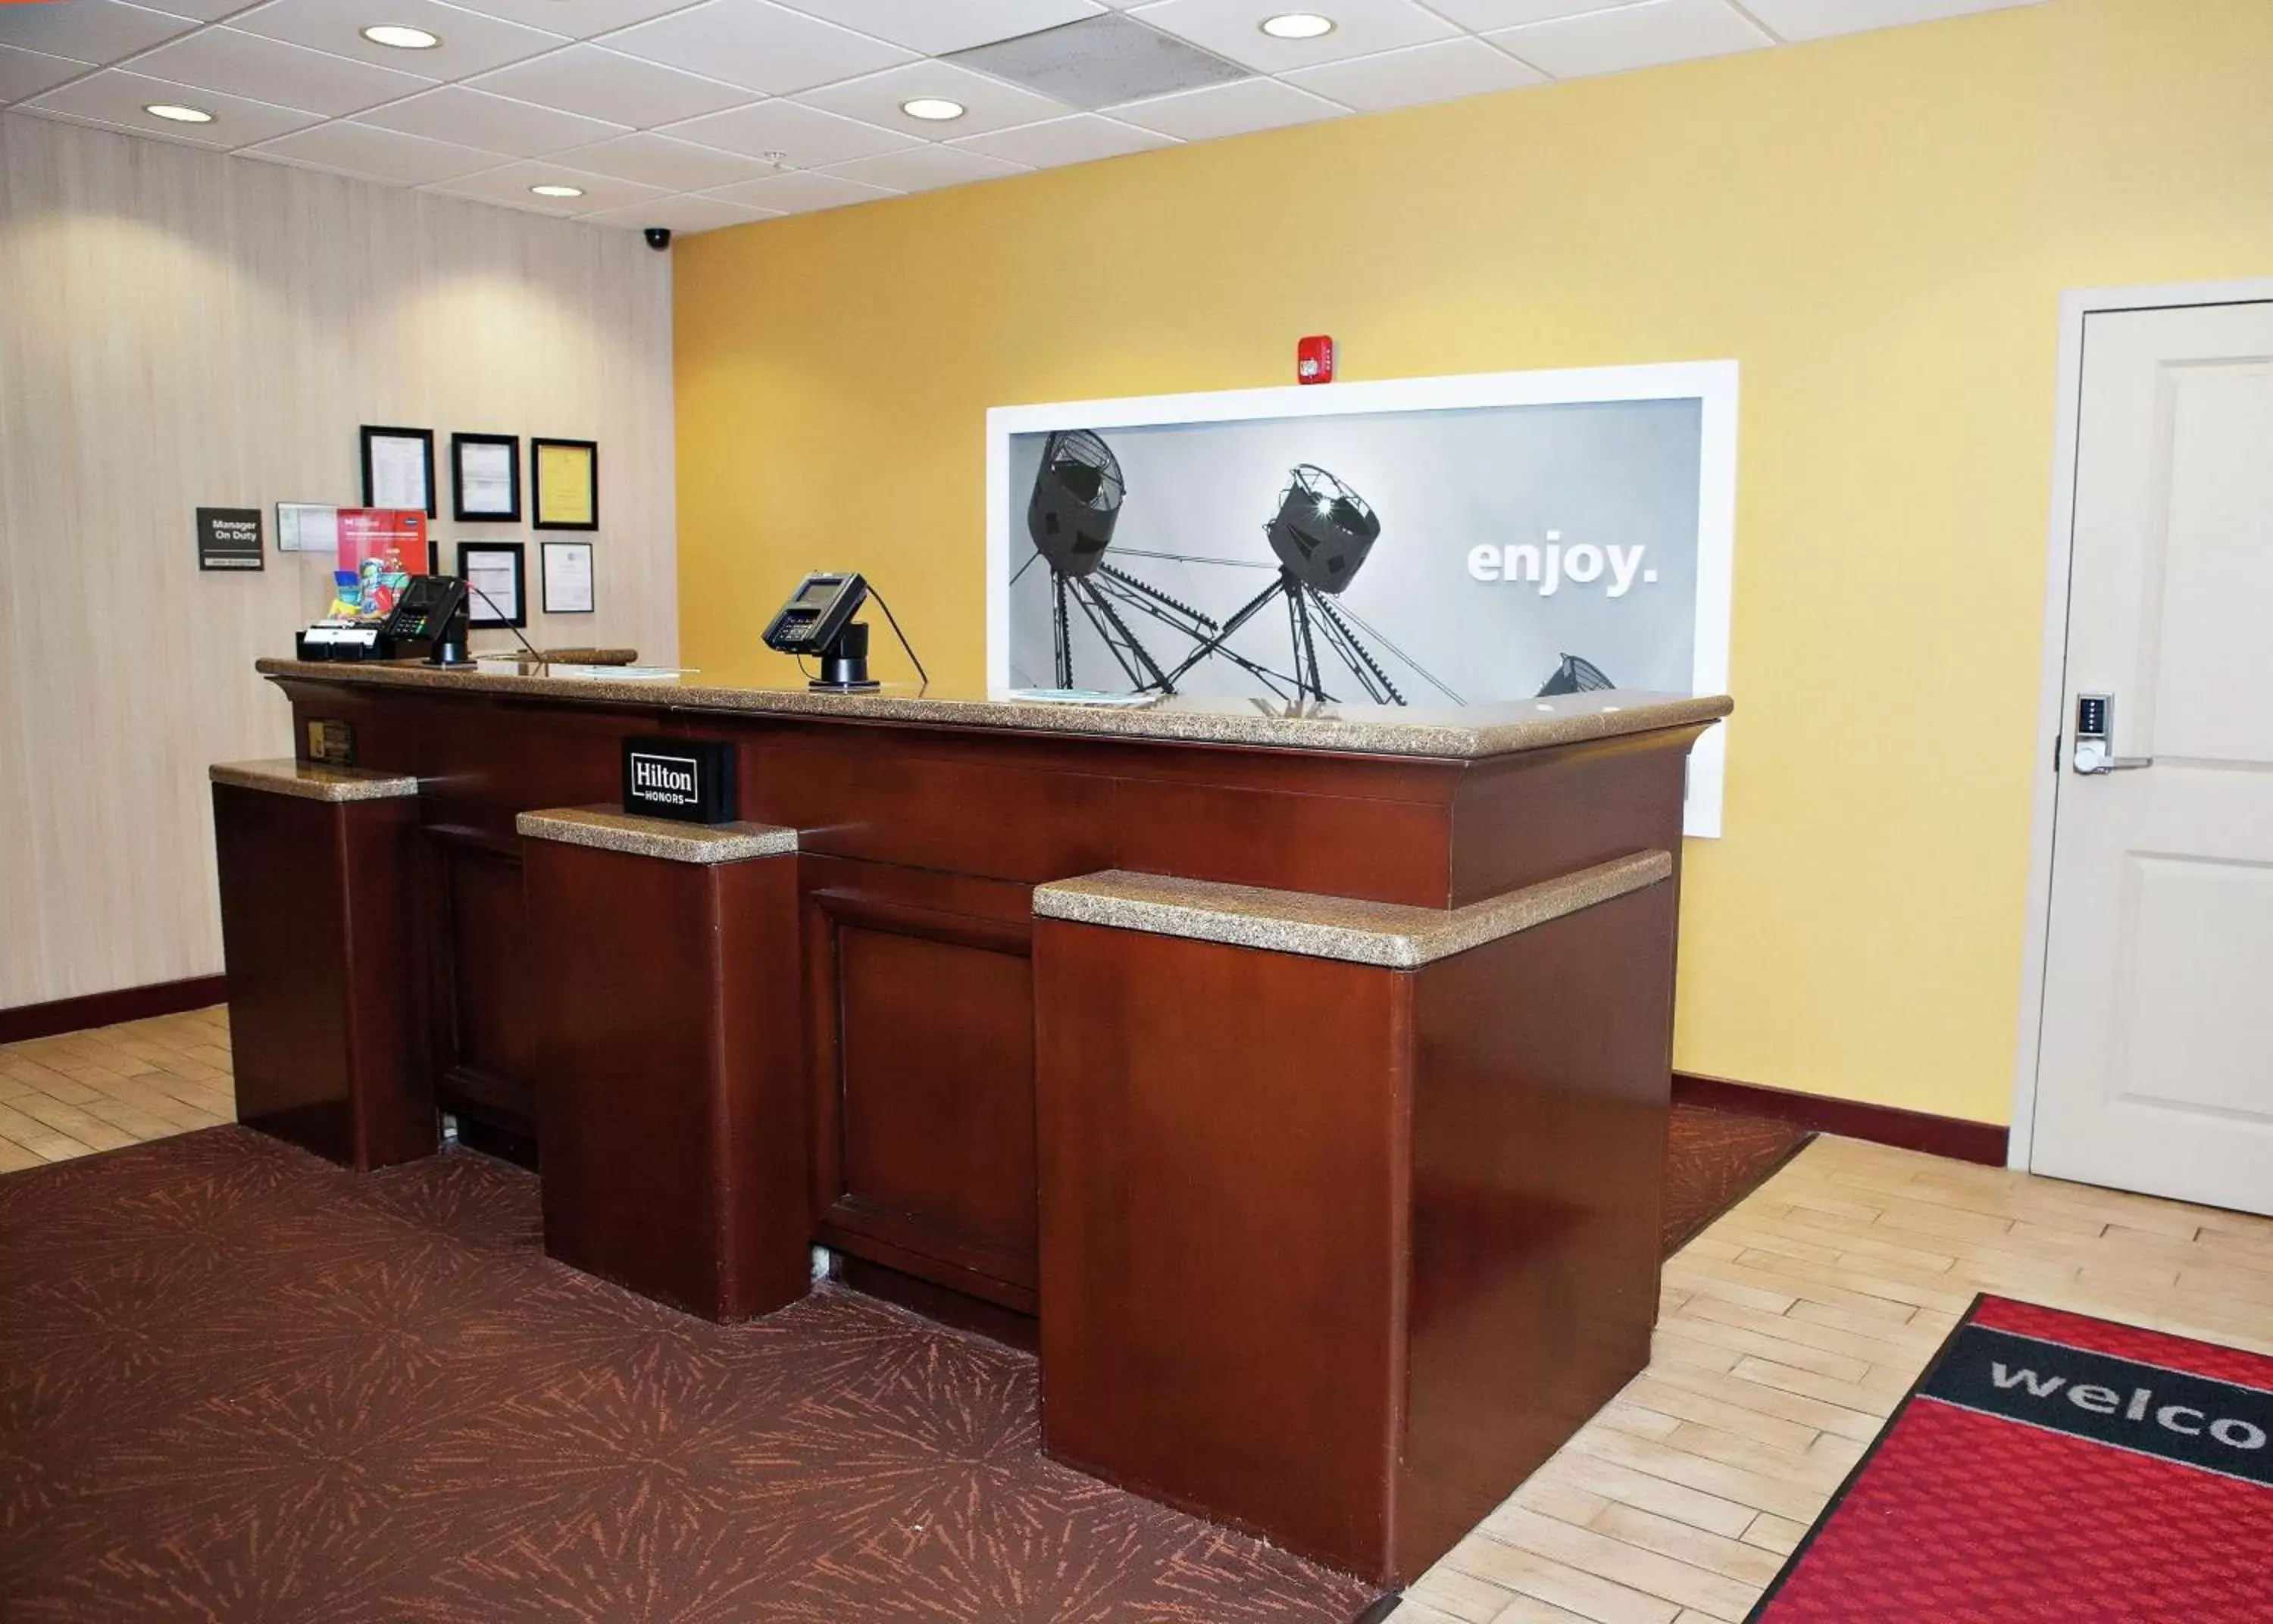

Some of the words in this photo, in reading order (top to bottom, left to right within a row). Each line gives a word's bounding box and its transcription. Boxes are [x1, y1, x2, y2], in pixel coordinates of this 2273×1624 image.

[212, 520, 256, 532] Manager
[215, 530, 231, 539] On
[233, 530, 257, 542] Duty
[1468, 530, 1658, 598] enjoy.
[636, 761, 692, 791] Hilton
[645, 790, 684, 804] HONORS
[1991, 1361, 2267, 1451] welco
